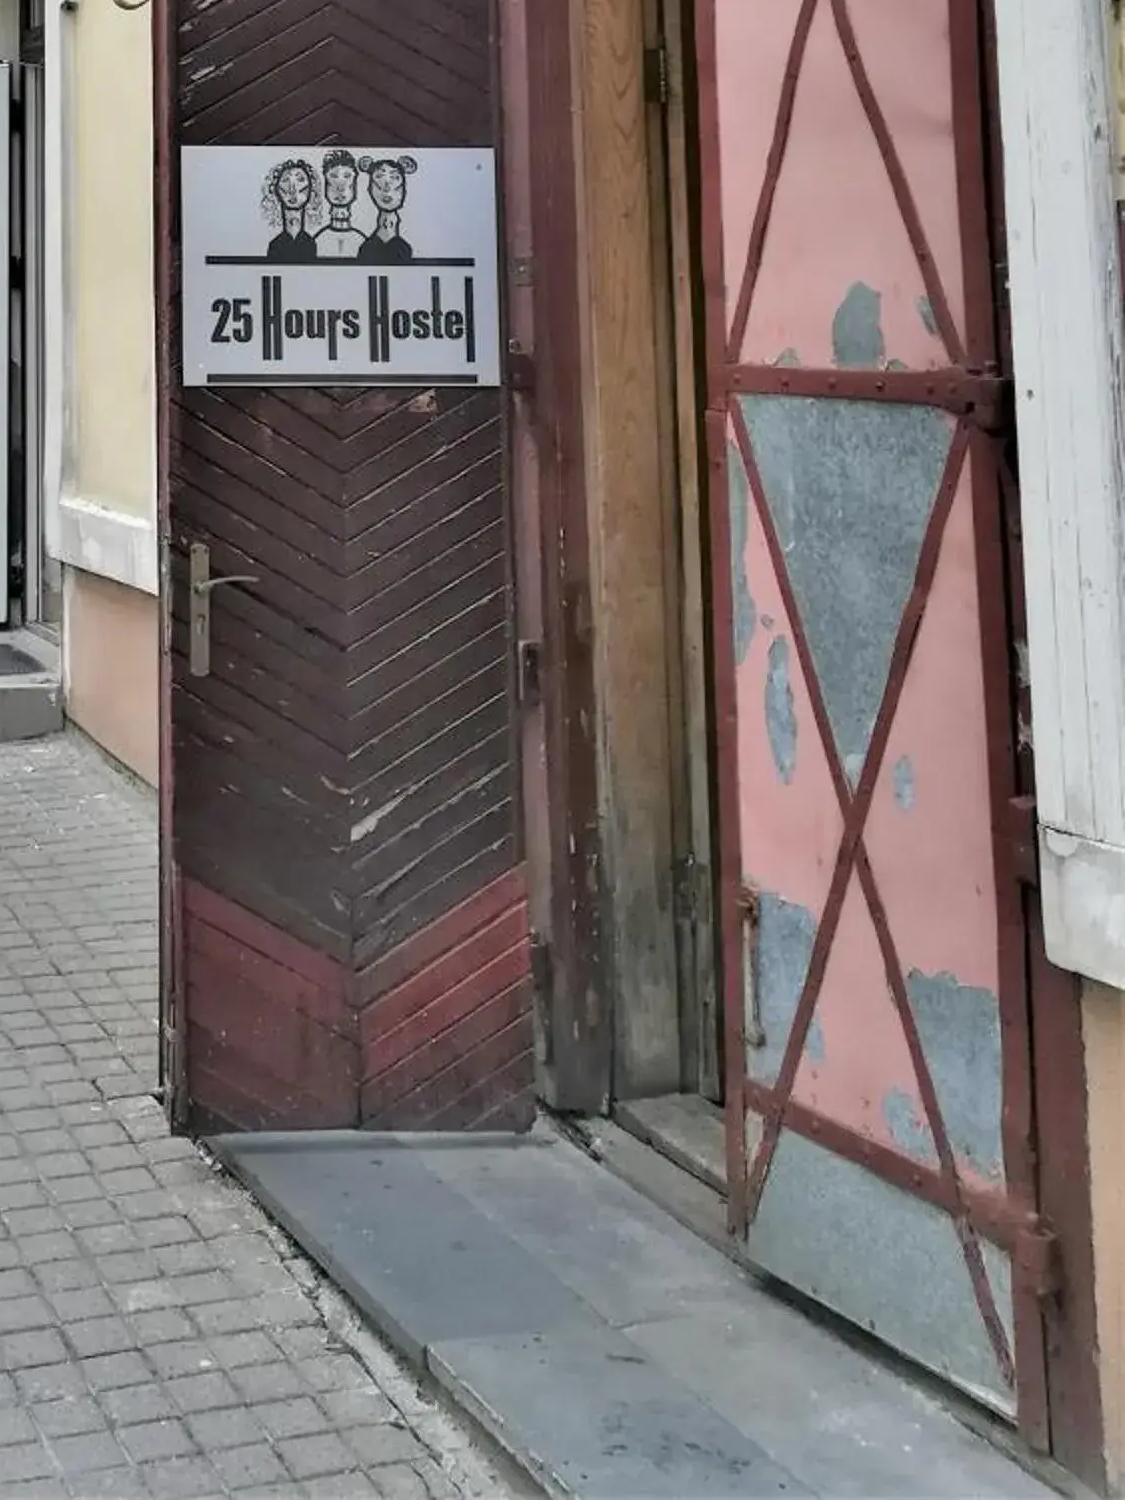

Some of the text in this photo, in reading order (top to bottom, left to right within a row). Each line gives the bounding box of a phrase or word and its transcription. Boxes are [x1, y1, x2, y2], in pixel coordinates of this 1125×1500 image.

[210, 275, 476, 363] 25 Hours Hostel
